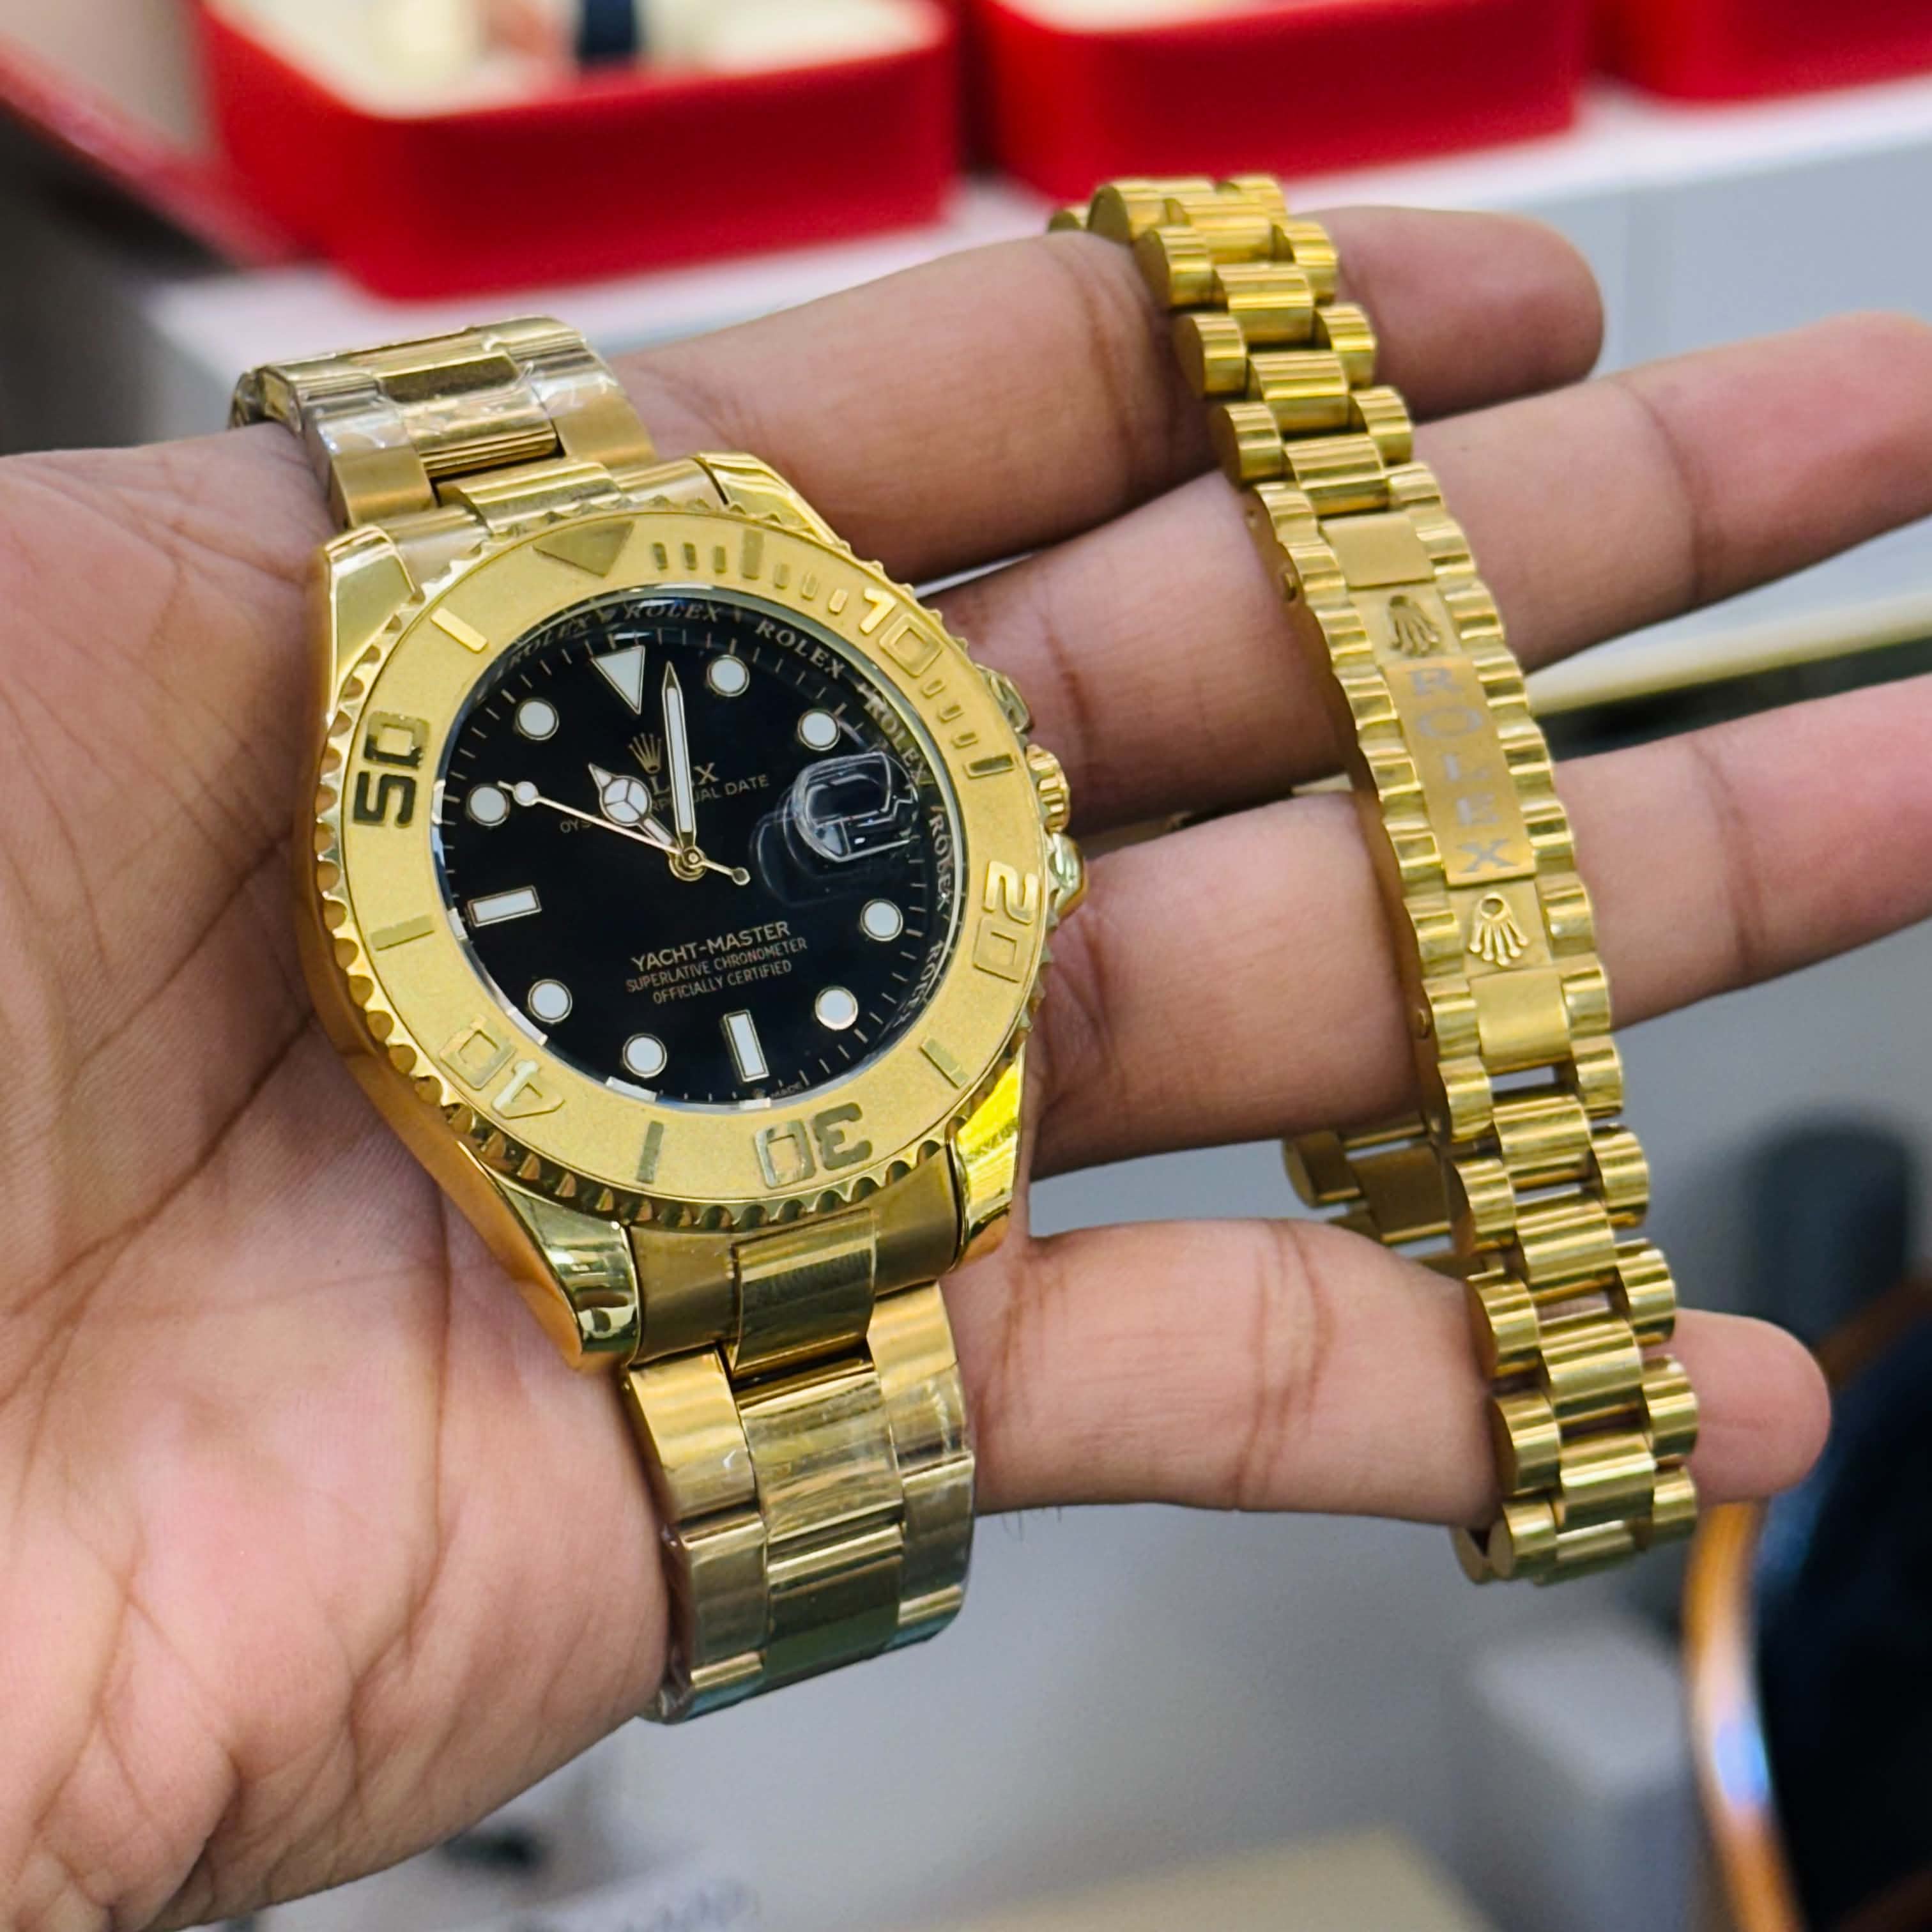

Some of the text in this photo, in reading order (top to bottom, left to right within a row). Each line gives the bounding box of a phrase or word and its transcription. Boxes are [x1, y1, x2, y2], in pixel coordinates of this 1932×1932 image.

[755, 620, 846, 679] ROLEX
[859, 587, 943, 677] 10
[353, 710, 431, 829] 50
[724, 774, 770, 796] DATE
[1411, 667, 1519, 874] ROLEX
[625, 937, 808, 993] SUPERLATIVE CHRONOMETER
[631, 921, 791, 972] YACHT-MASTER
[973, 860, 1039, 983] 20
[652, 960, 793, 1005] OFFICIALLY CERTIFIED
[440, 1015, 565, 1120] 40
[753, 1101, 873, 1189] 30
